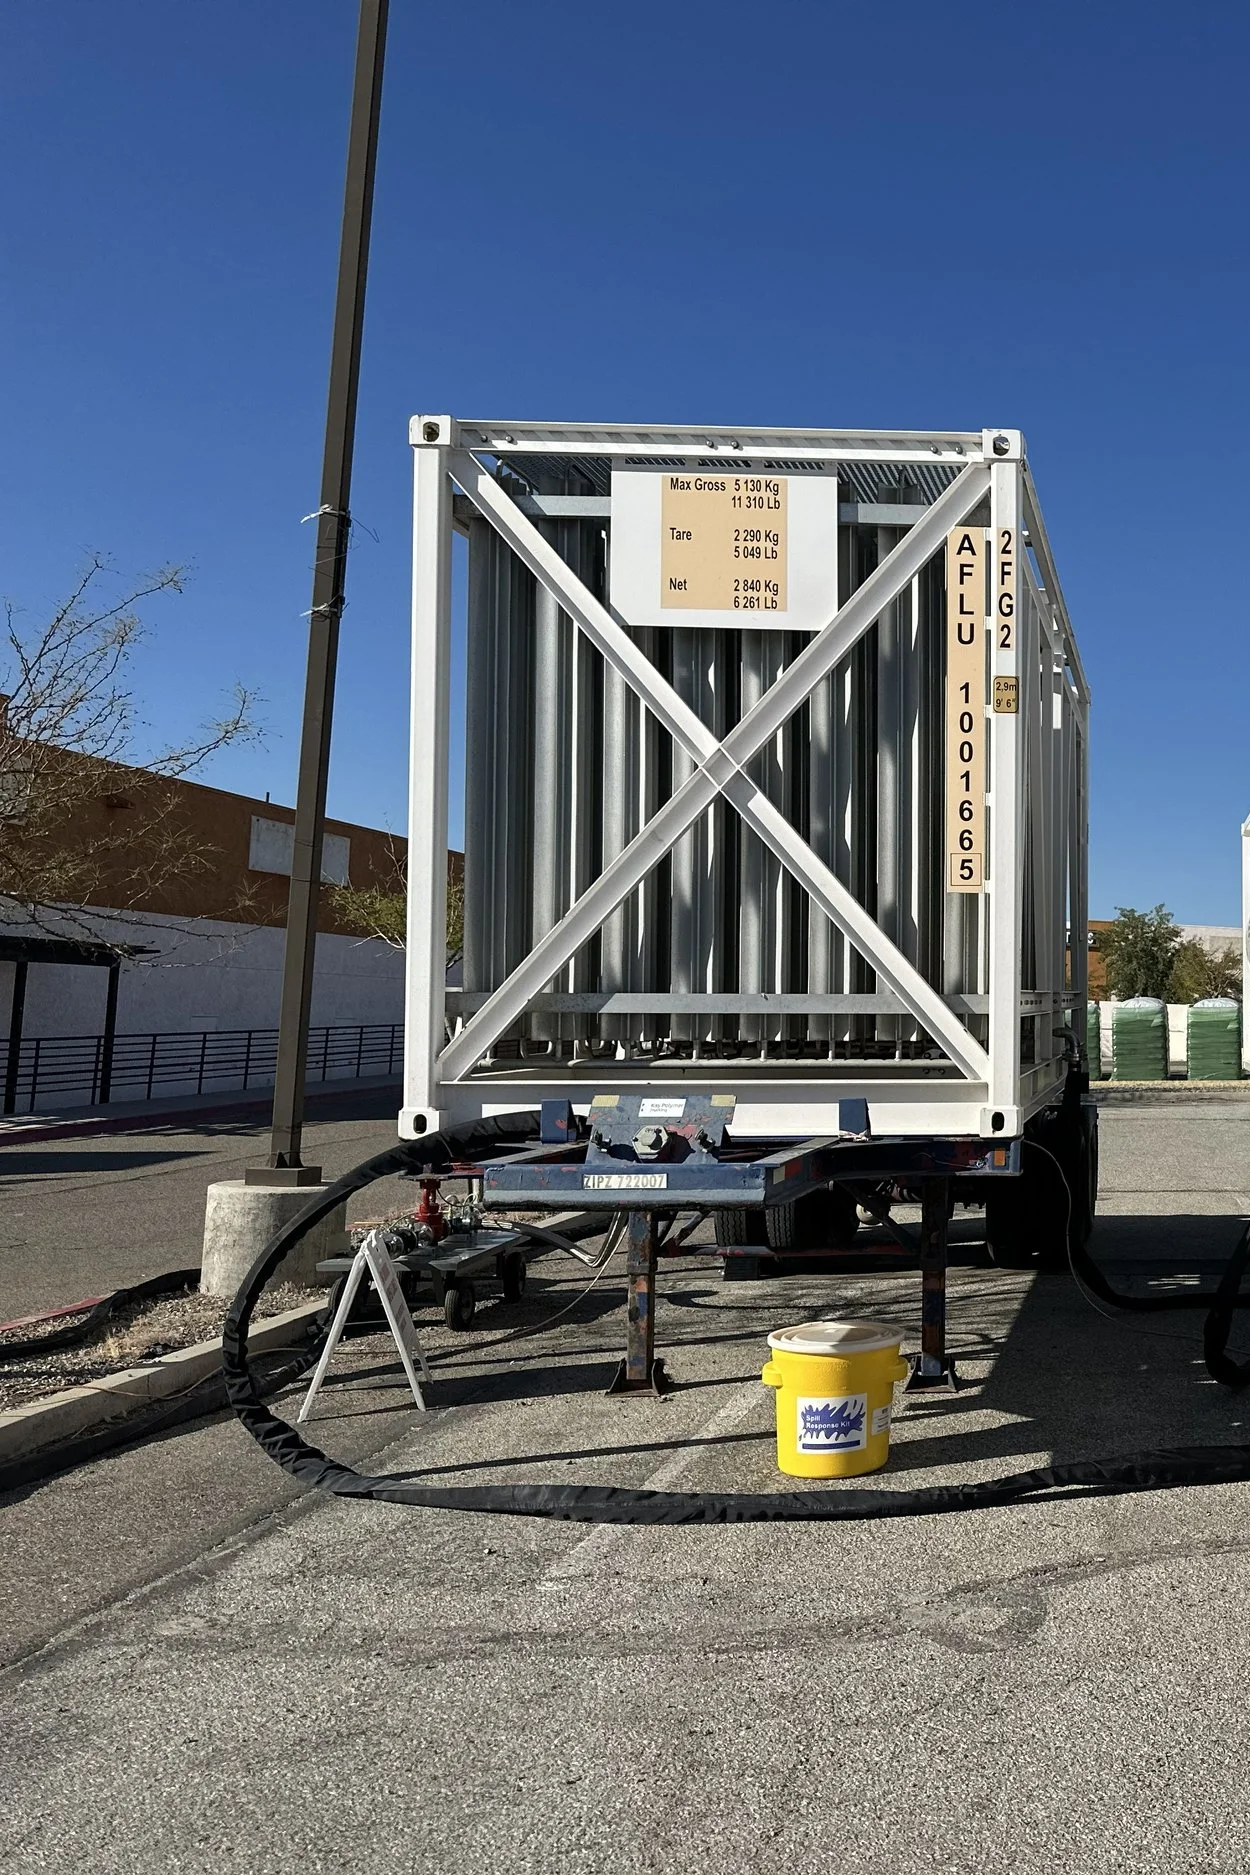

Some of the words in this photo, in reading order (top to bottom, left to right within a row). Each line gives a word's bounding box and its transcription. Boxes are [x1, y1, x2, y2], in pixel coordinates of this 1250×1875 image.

[670, 478, 691, 490] Max
[695, 478, 726, 491] Gross
[734, 479, 741, 491] 5
[744, 480, 762, 492] 130
[765, 480, 779, 496] Kg
[731, 496, 742, 508] 11
[746, 496, 764, 509] 310
[767, 497, 780, 510] Lb
[669, 527, 692, 540] Tare
[734, 529, 740, 541] 2
[743, 530, 761, 542] 290
[764, 530, 779, 546] Kg
[734, 546, 740, 558] 5
[743, 546, 761, 559] 049
[764, 547, 778, 559] Lb
[669, 578, 687, 590] Net
[734, 579, 740, 592] 2
[743, 579, 761, 592] 840
[764, 580, 779, 596] Kg
[956, 534, 977, 645] AFLU
[734, 596, 740, 608] 6
[743, 596, 760, 609] 261
[764, 597, 778, 609] Lb
[583, 1175, 613, 1189] ZIPZ
[617, 1175, 665, 1188] 722007
[805, 1414, 820, 1422] Spill
[805, 1422, 839, 1430] Response
